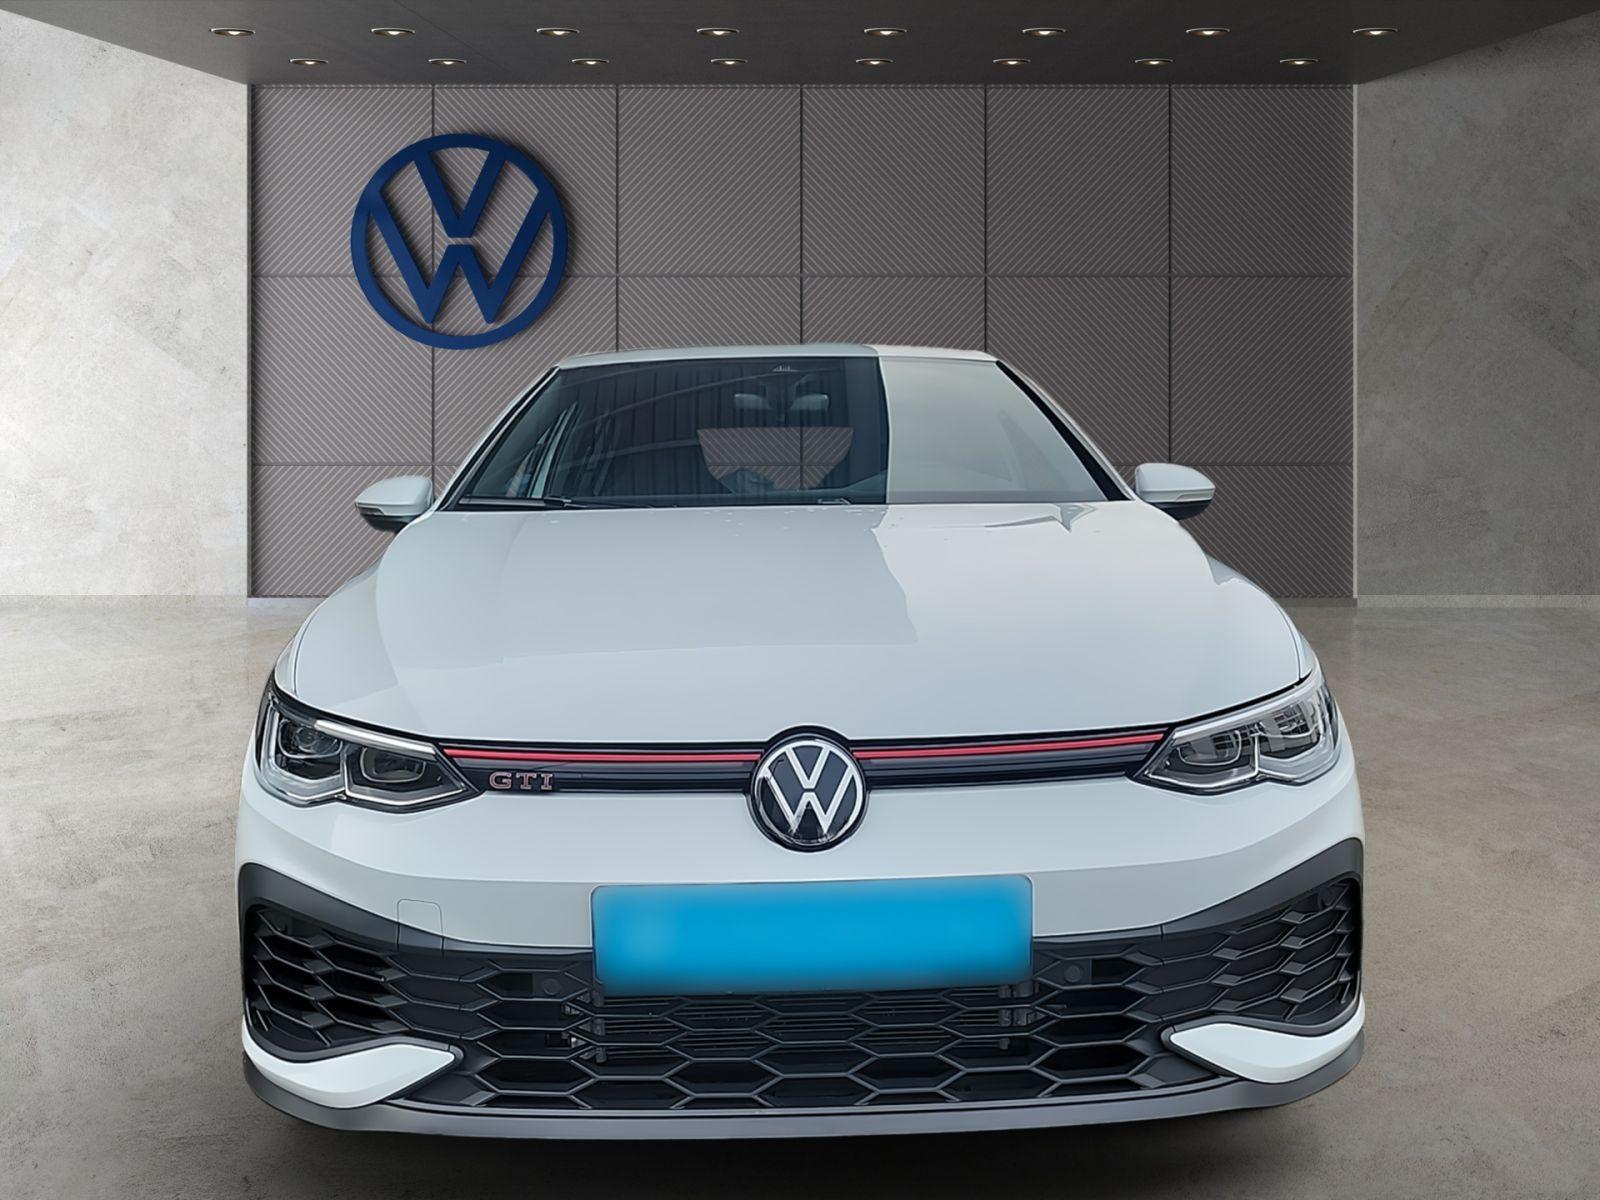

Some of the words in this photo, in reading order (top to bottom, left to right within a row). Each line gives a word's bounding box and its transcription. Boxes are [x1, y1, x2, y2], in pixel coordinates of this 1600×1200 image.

[360, 146, 560, 325] VW
[489, 771, 553, 791] GTI
[760, 743, 857, 835] VW
